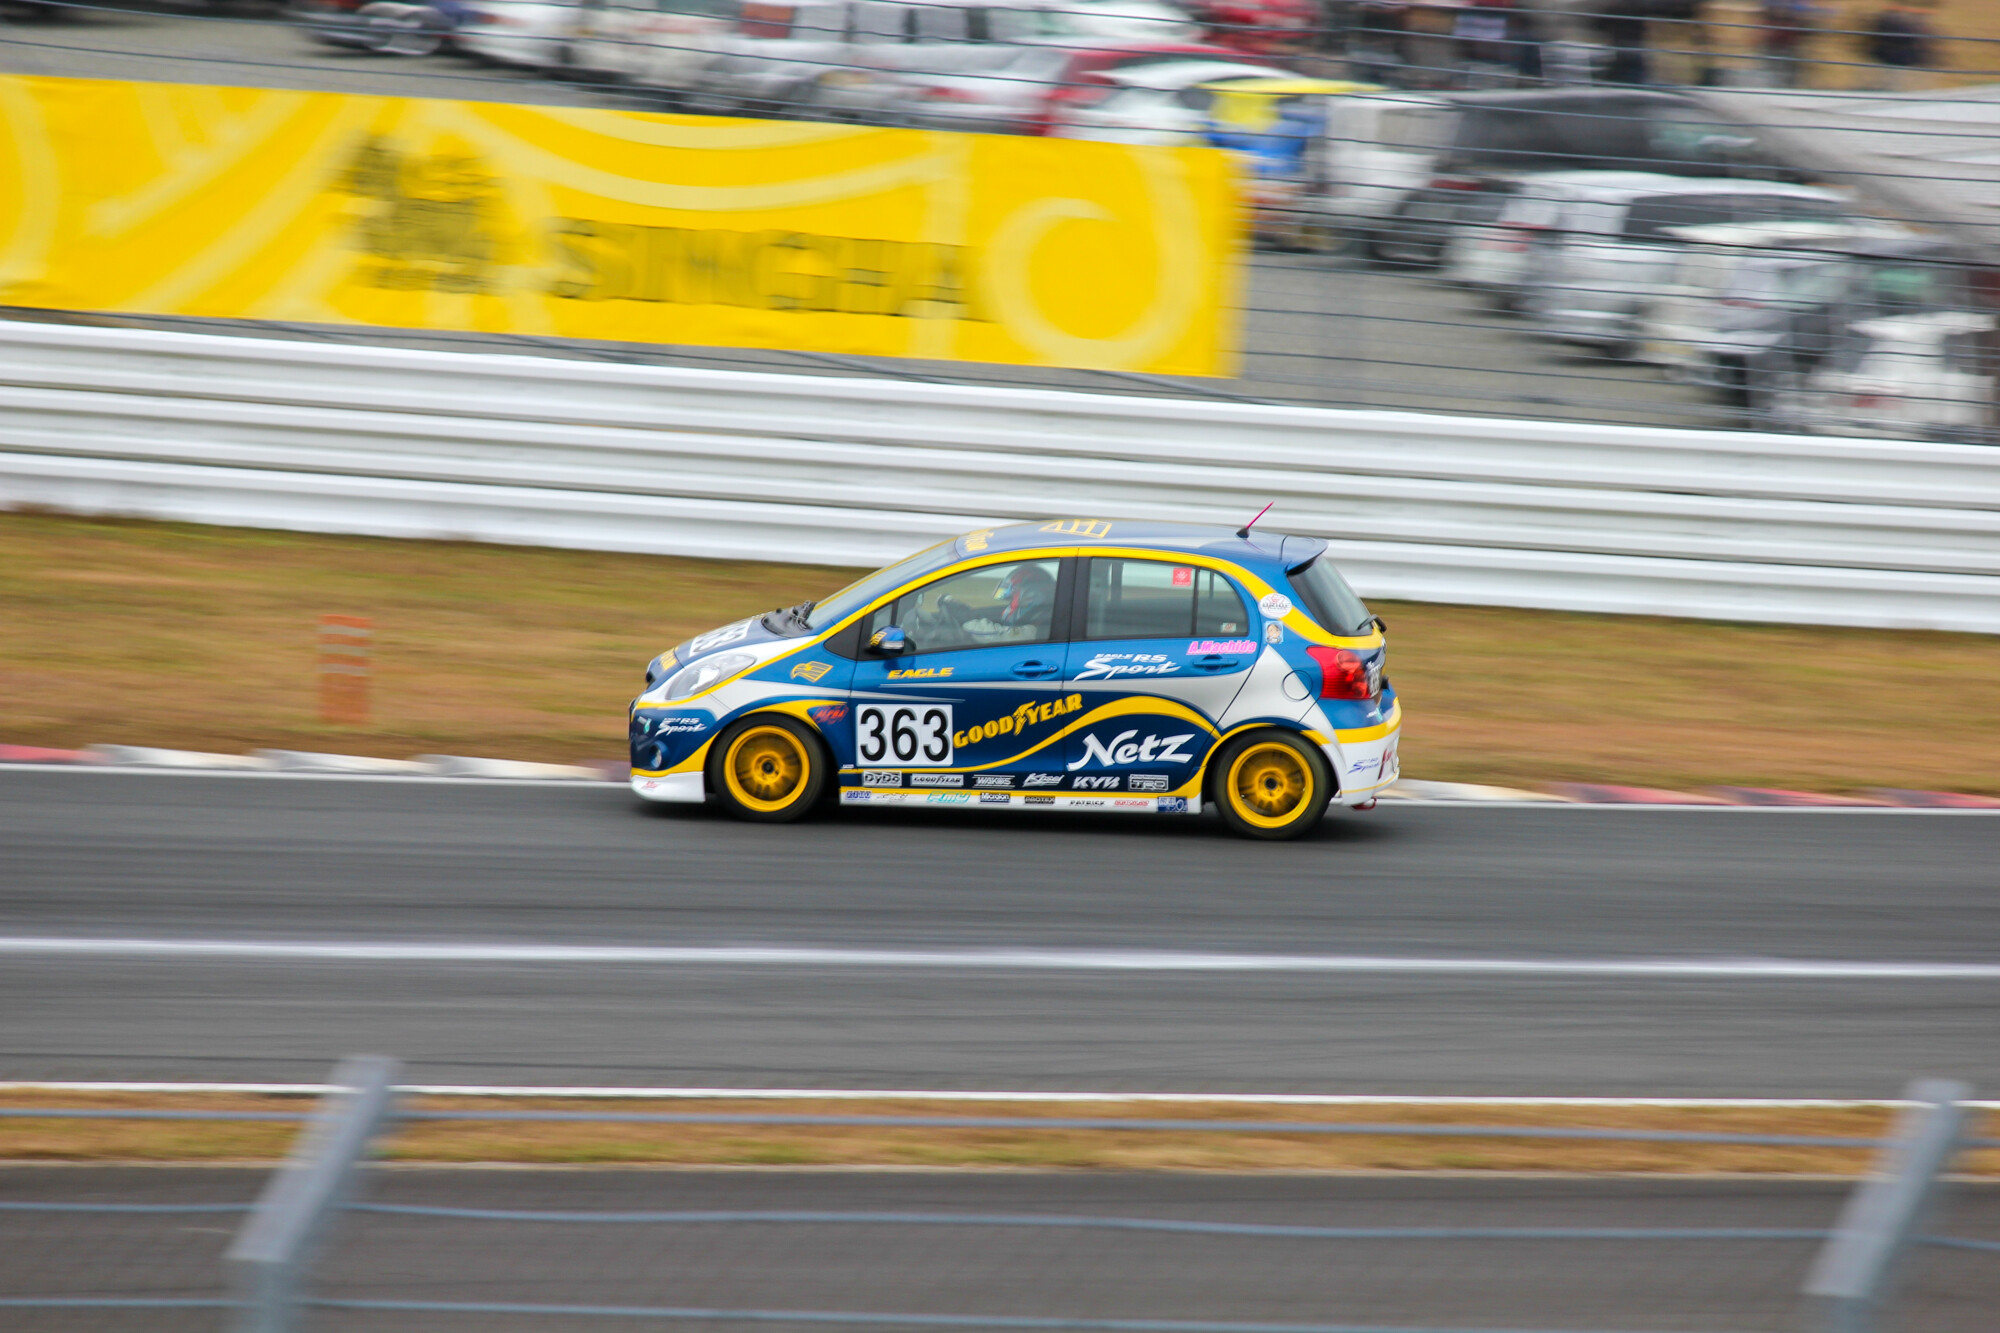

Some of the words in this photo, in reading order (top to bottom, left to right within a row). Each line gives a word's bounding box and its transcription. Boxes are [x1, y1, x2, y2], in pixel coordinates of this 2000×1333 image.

[1186, 640, 1257, 655] A.Machida
[1132, 653, 1168, 663] RS
[887, 667, 954, 680] EAGLE
[1072, 658, 1181, 682] Sport
[953, 693, 1083, 748] GOODYEAR
[655, 721, 707, 736] Sport
[860, 707, 951, 762] 363
[1066, 729, 1196, 771] Netz
[864, 773, 900, 784] DyDo
[1072, 776, 1120, 790] KYB
[1131, 780, 1166, 791] TRD
